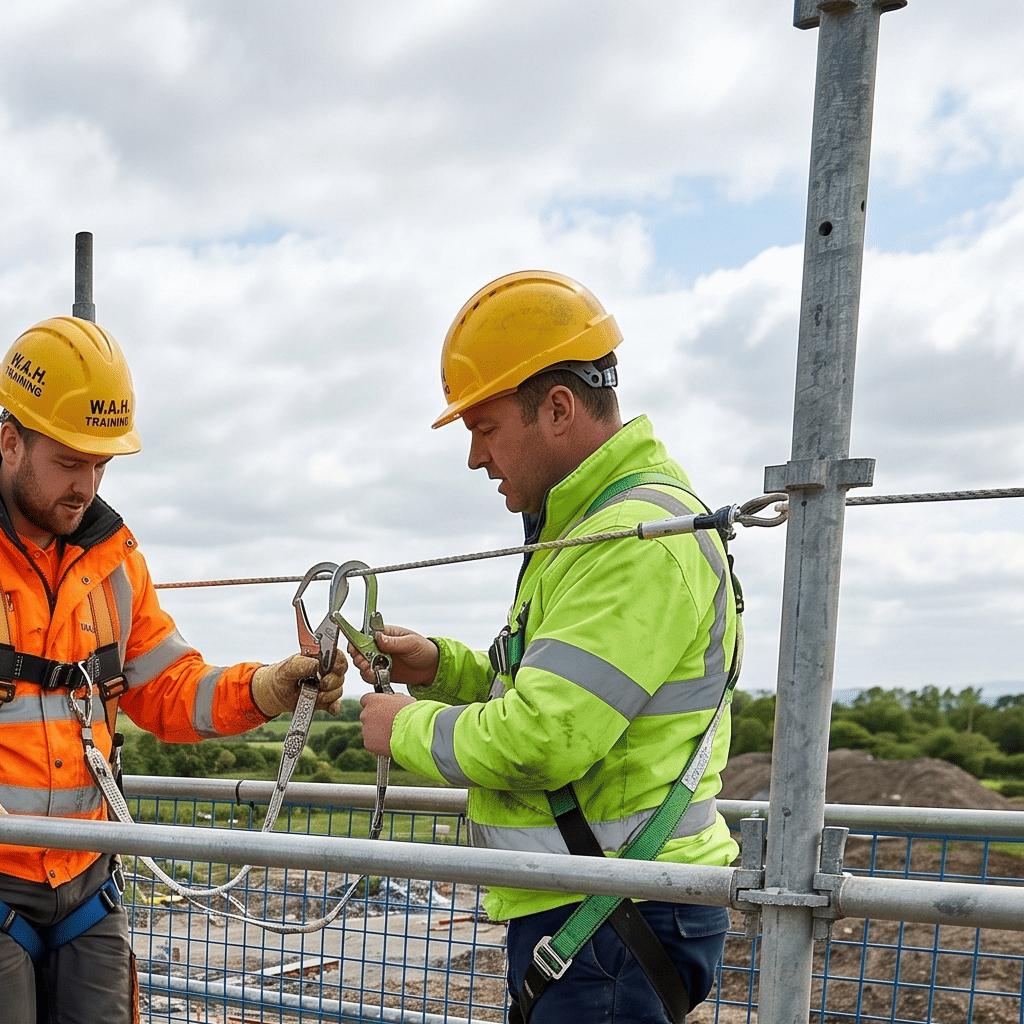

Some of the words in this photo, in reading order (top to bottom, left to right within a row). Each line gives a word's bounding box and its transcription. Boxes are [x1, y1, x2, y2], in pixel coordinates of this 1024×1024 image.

[5, 365, 42, 397] TRAINING
[10, 352, 46, 386] W.A.H.
[89, 399, 130, 415] W.A.H.
